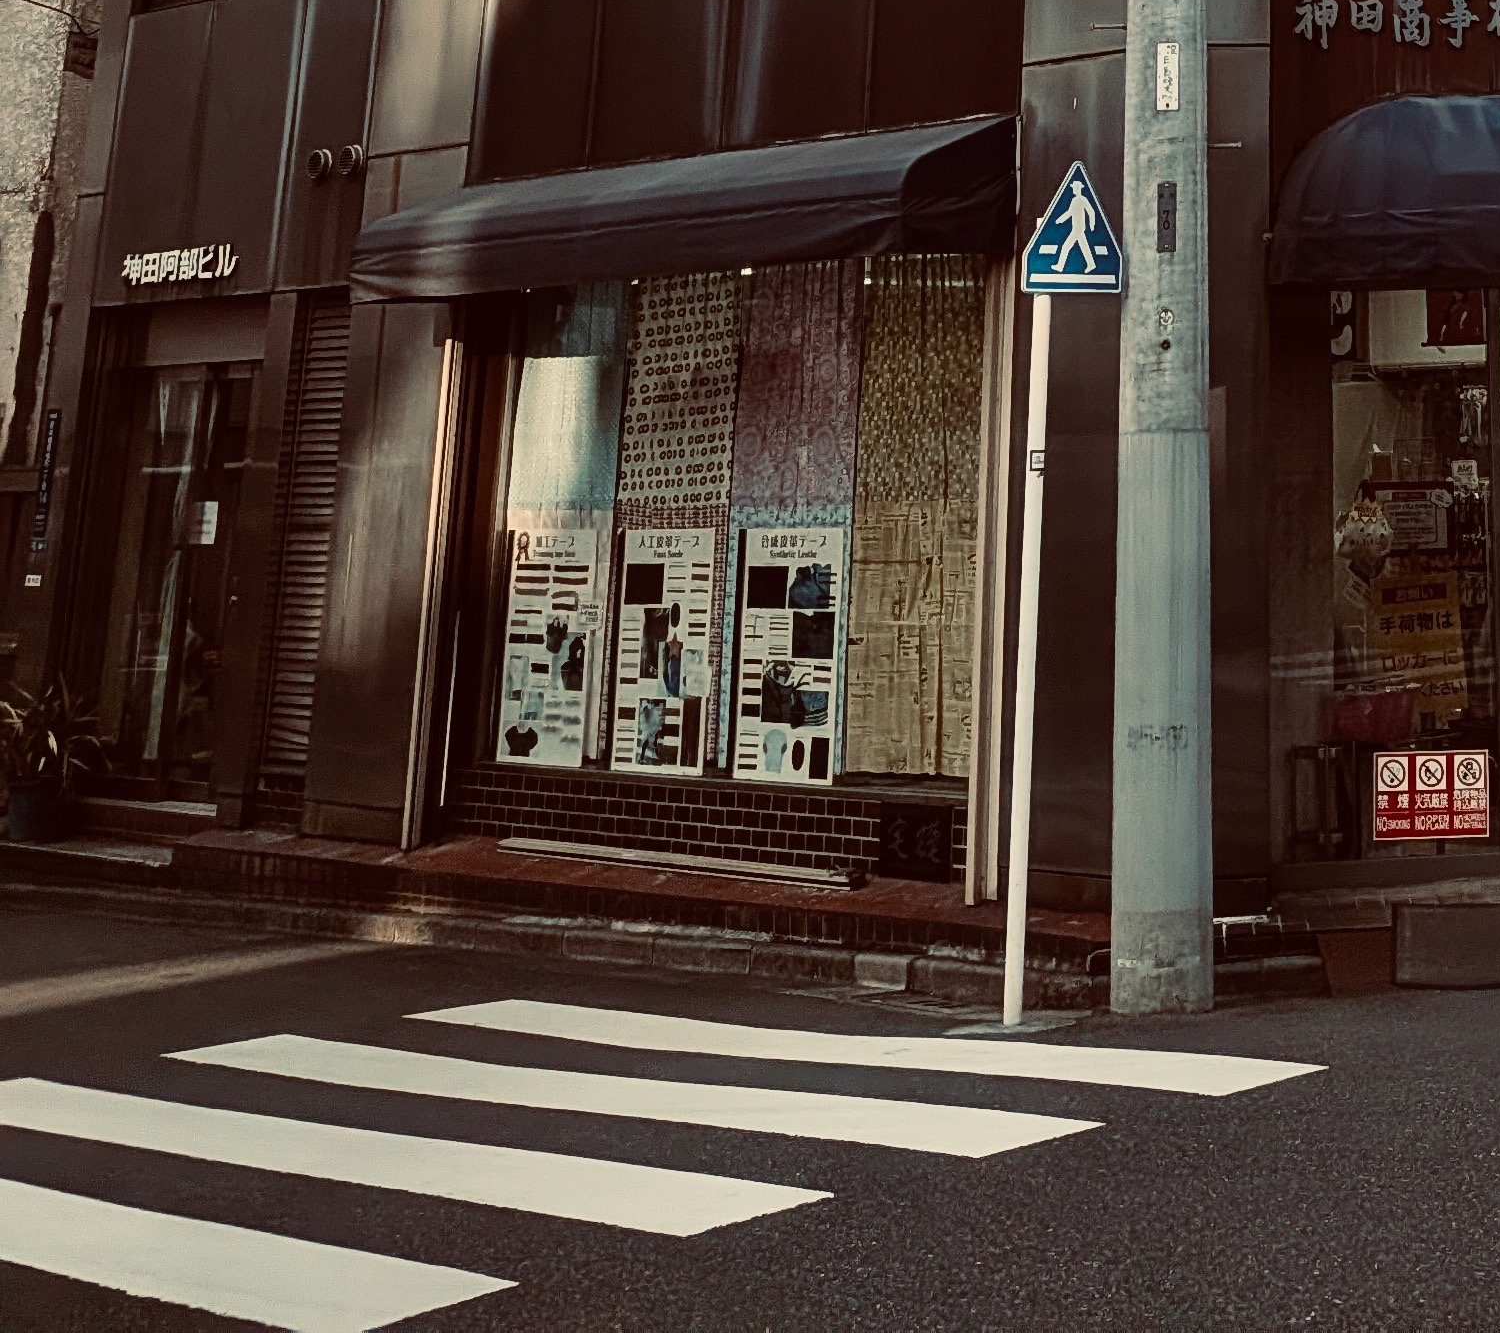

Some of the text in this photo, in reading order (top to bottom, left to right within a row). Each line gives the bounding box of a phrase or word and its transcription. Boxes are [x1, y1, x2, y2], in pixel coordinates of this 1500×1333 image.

[120, 243, 241, 286] 神田阿部ビル
[1379, 610, 1455, 635] 手荷物は
[1381, 649, 1458, 673] ロッカーに
[1376, 816, 1388, 832] NO
[1414, 815, 1426, 831] NO
[1453, 814, 1464, 830] NO
